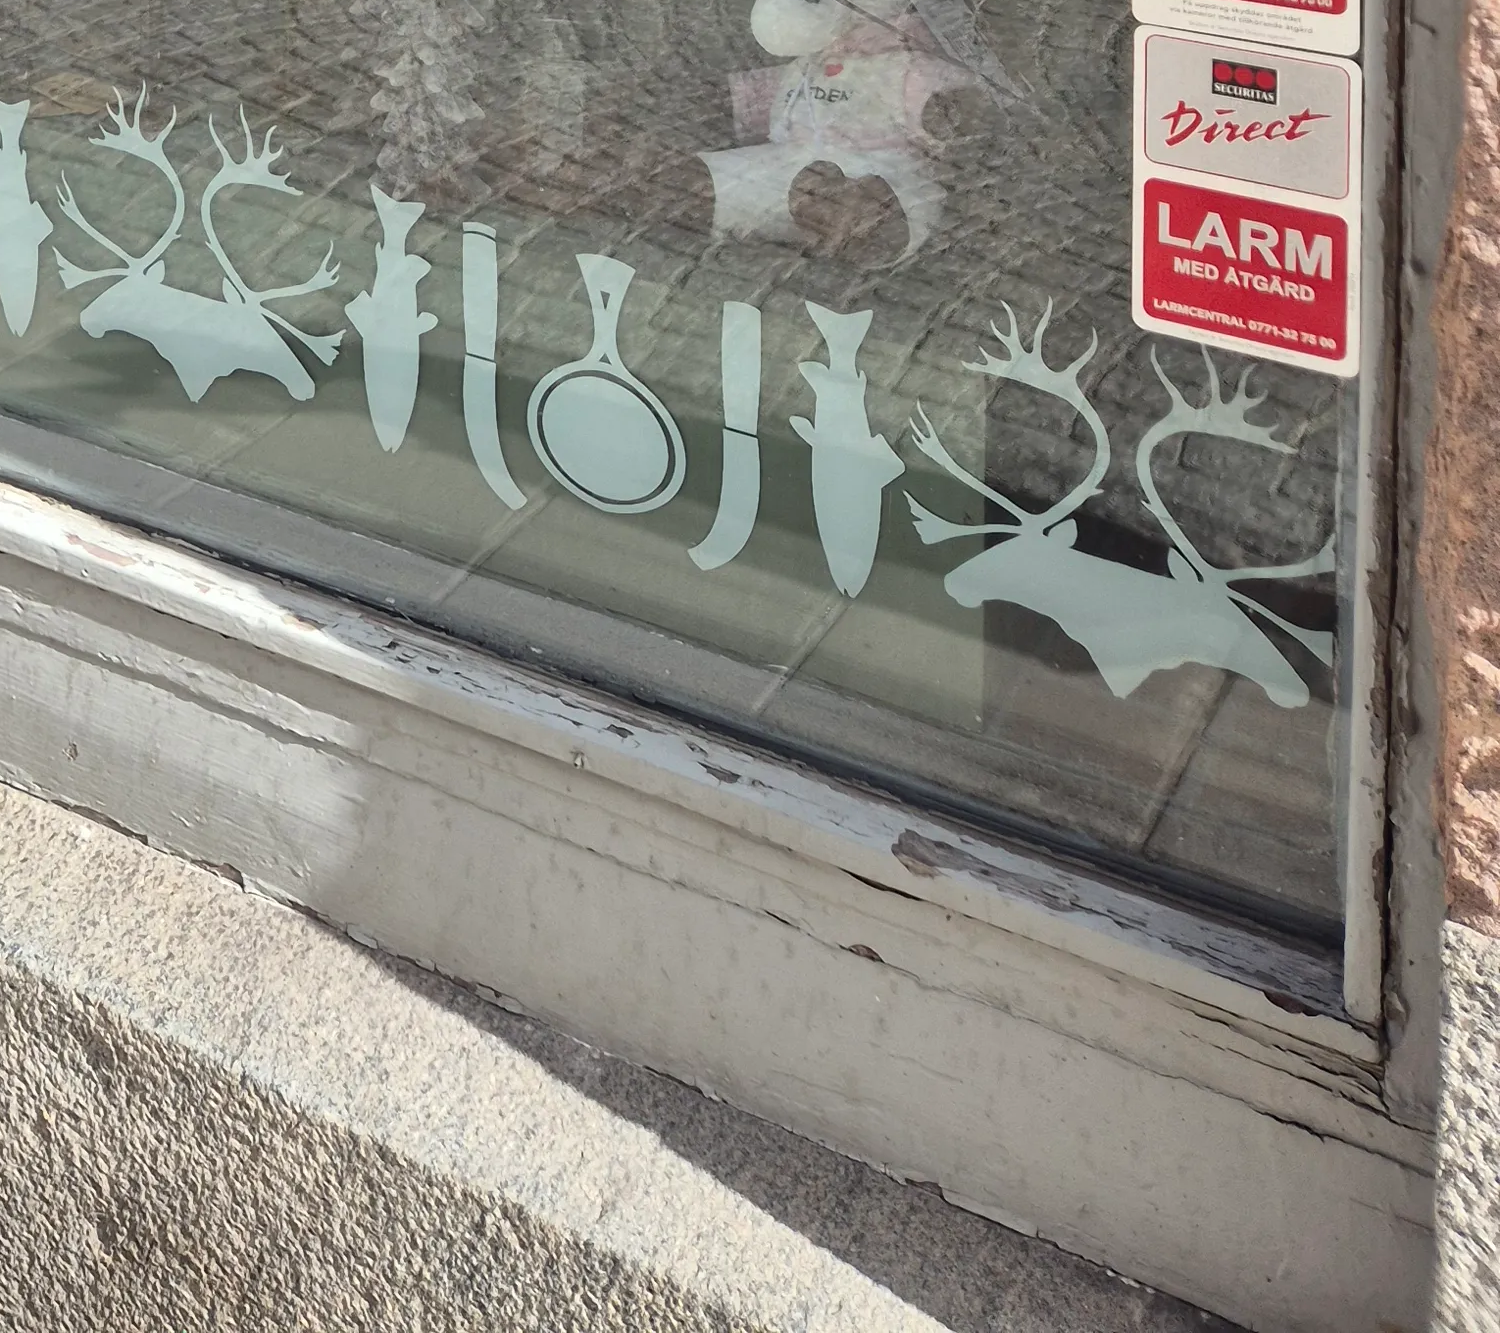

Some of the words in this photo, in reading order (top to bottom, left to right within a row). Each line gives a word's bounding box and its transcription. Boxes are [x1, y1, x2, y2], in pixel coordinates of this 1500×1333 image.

[1214, 82, 1275, 103] SECURITAS
[1160, 100, 1332, 148] Direct
[1157, 201, 1333, 281] LARM
[1173, 256, 1220, 281] MED
[1223, 266, 1316, 304] ÅTGÄRD
[1153, 297, 1246, 329] LARMCENTRAL
